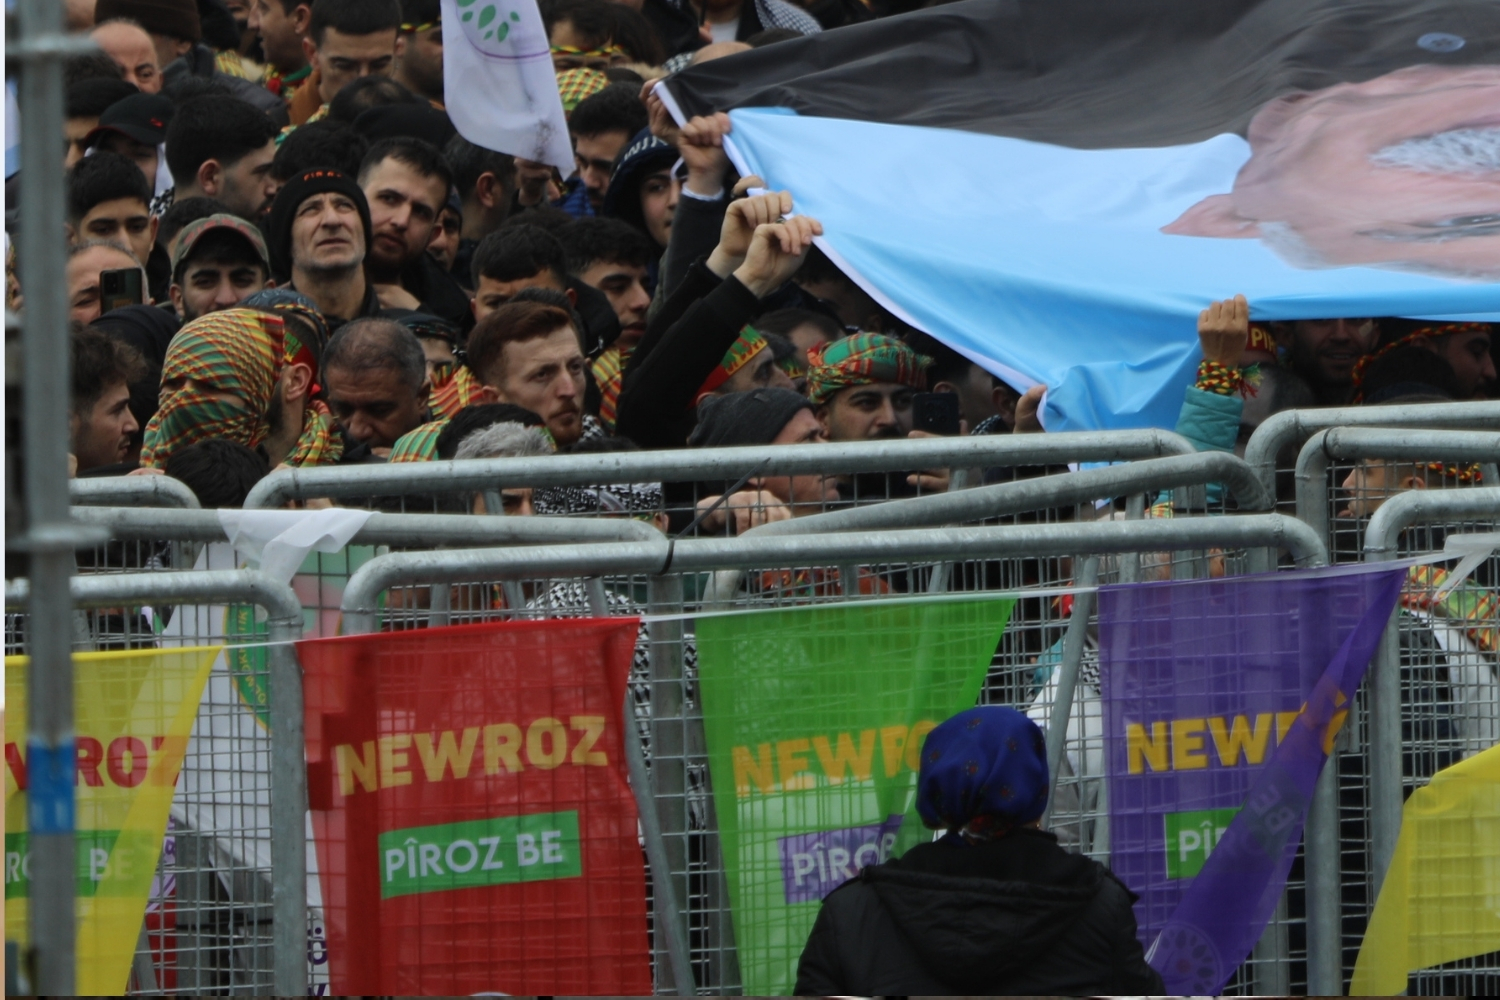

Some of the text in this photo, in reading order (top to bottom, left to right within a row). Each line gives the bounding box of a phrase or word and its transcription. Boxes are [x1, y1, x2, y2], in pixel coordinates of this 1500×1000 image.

[336, 715, 608, 796] NEWROZ
[732, 720, 942, 797] NEWRO
[385, 830, 563, 882] PÎROZ BE
